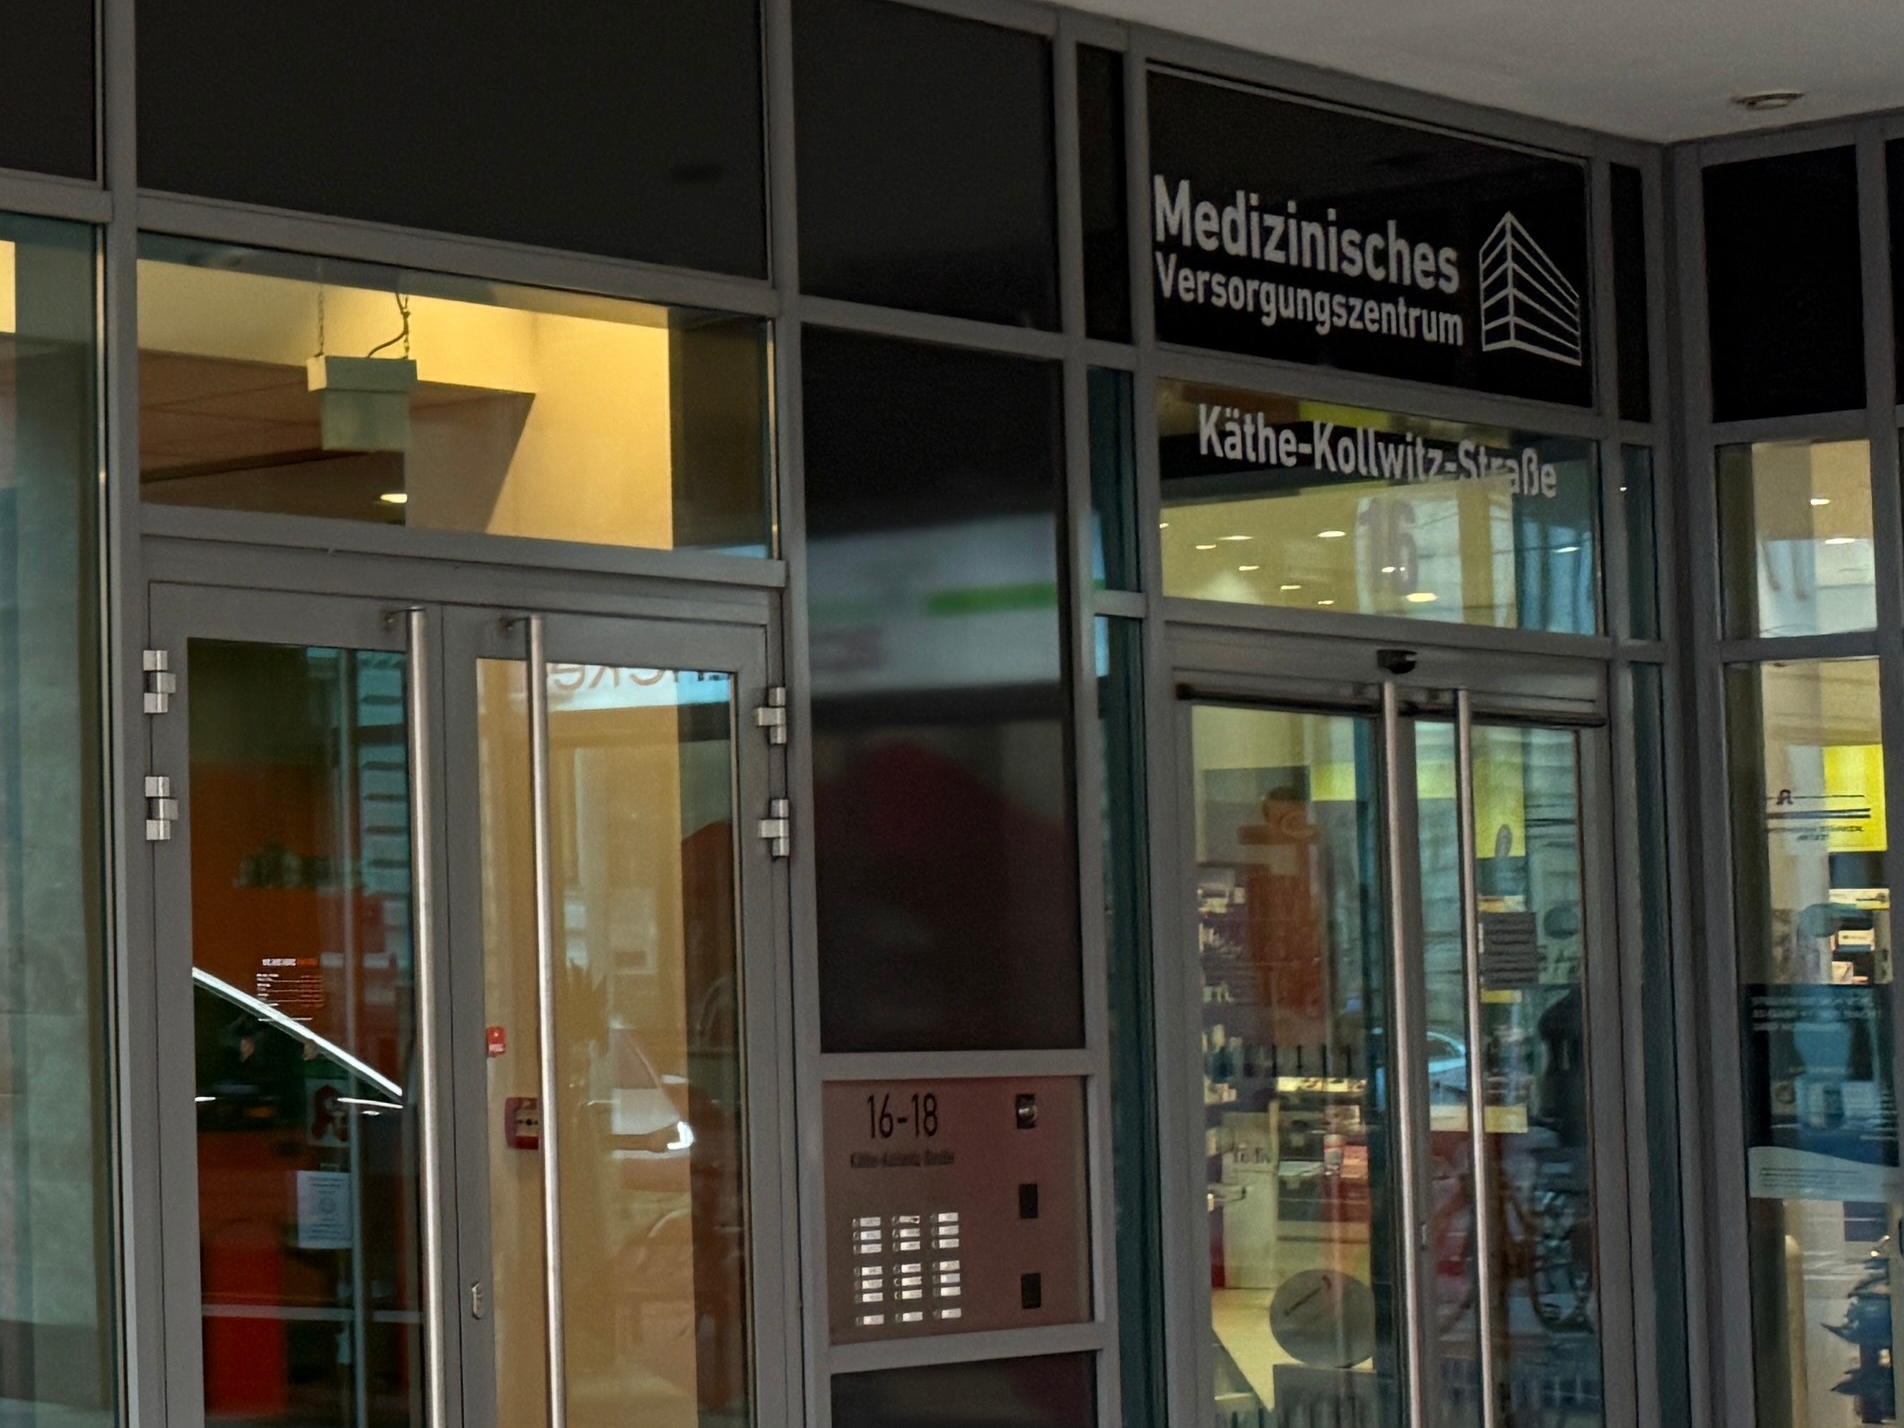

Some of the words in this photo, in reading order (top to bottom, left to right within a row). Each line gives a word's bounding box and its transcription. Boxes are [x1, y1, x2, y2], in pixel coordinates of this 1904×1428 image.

[1154, 174, 1460, 294] Medizinisches
[1155, 252, 1464, 347] Versorgungszentrum
[1198, 402, 1558, 500] Käthe-Kollwitz-Straße
[867, 1093, 939, 1139] 16-18
